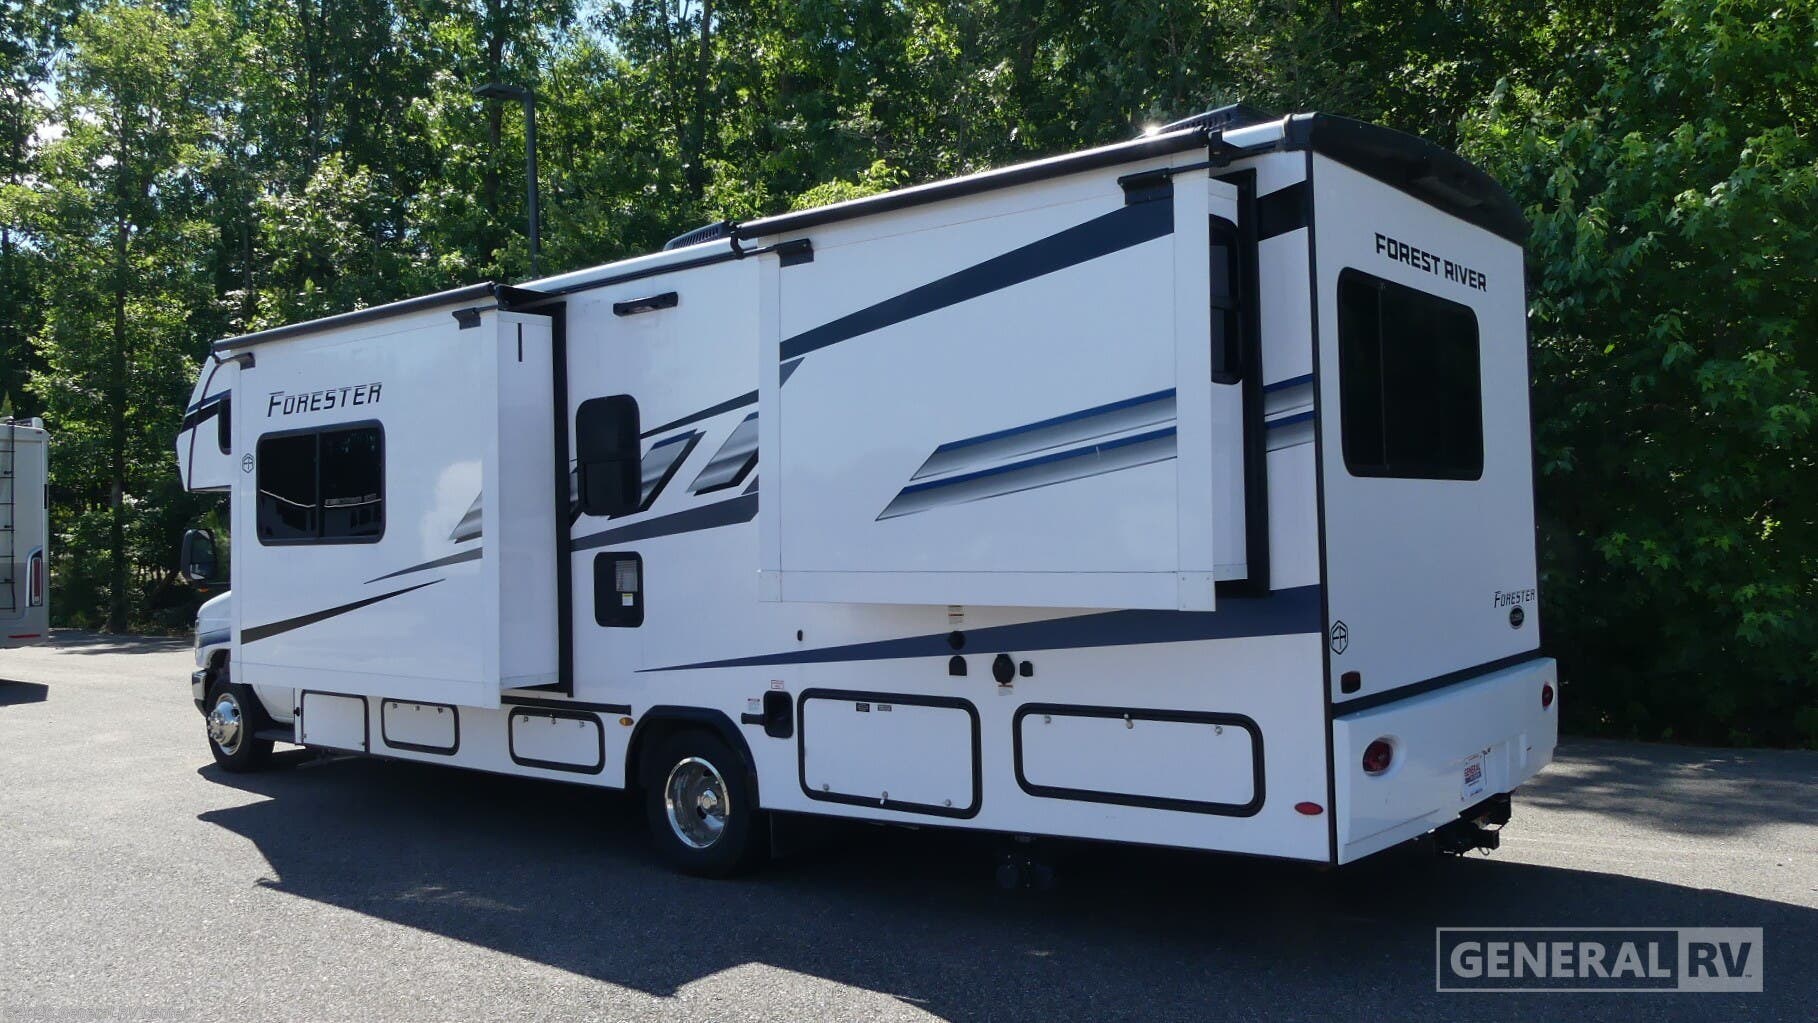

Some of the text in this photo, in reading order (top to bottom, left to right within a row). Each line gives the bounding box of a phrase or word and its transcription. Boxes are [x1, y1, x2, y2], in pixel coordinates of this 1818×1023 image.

[1375, 232, 1487, 292] FOREST RIVER
[267, 382, 382, 417] FORESTER
[1494, 589, 1535, 608] FORESTER
